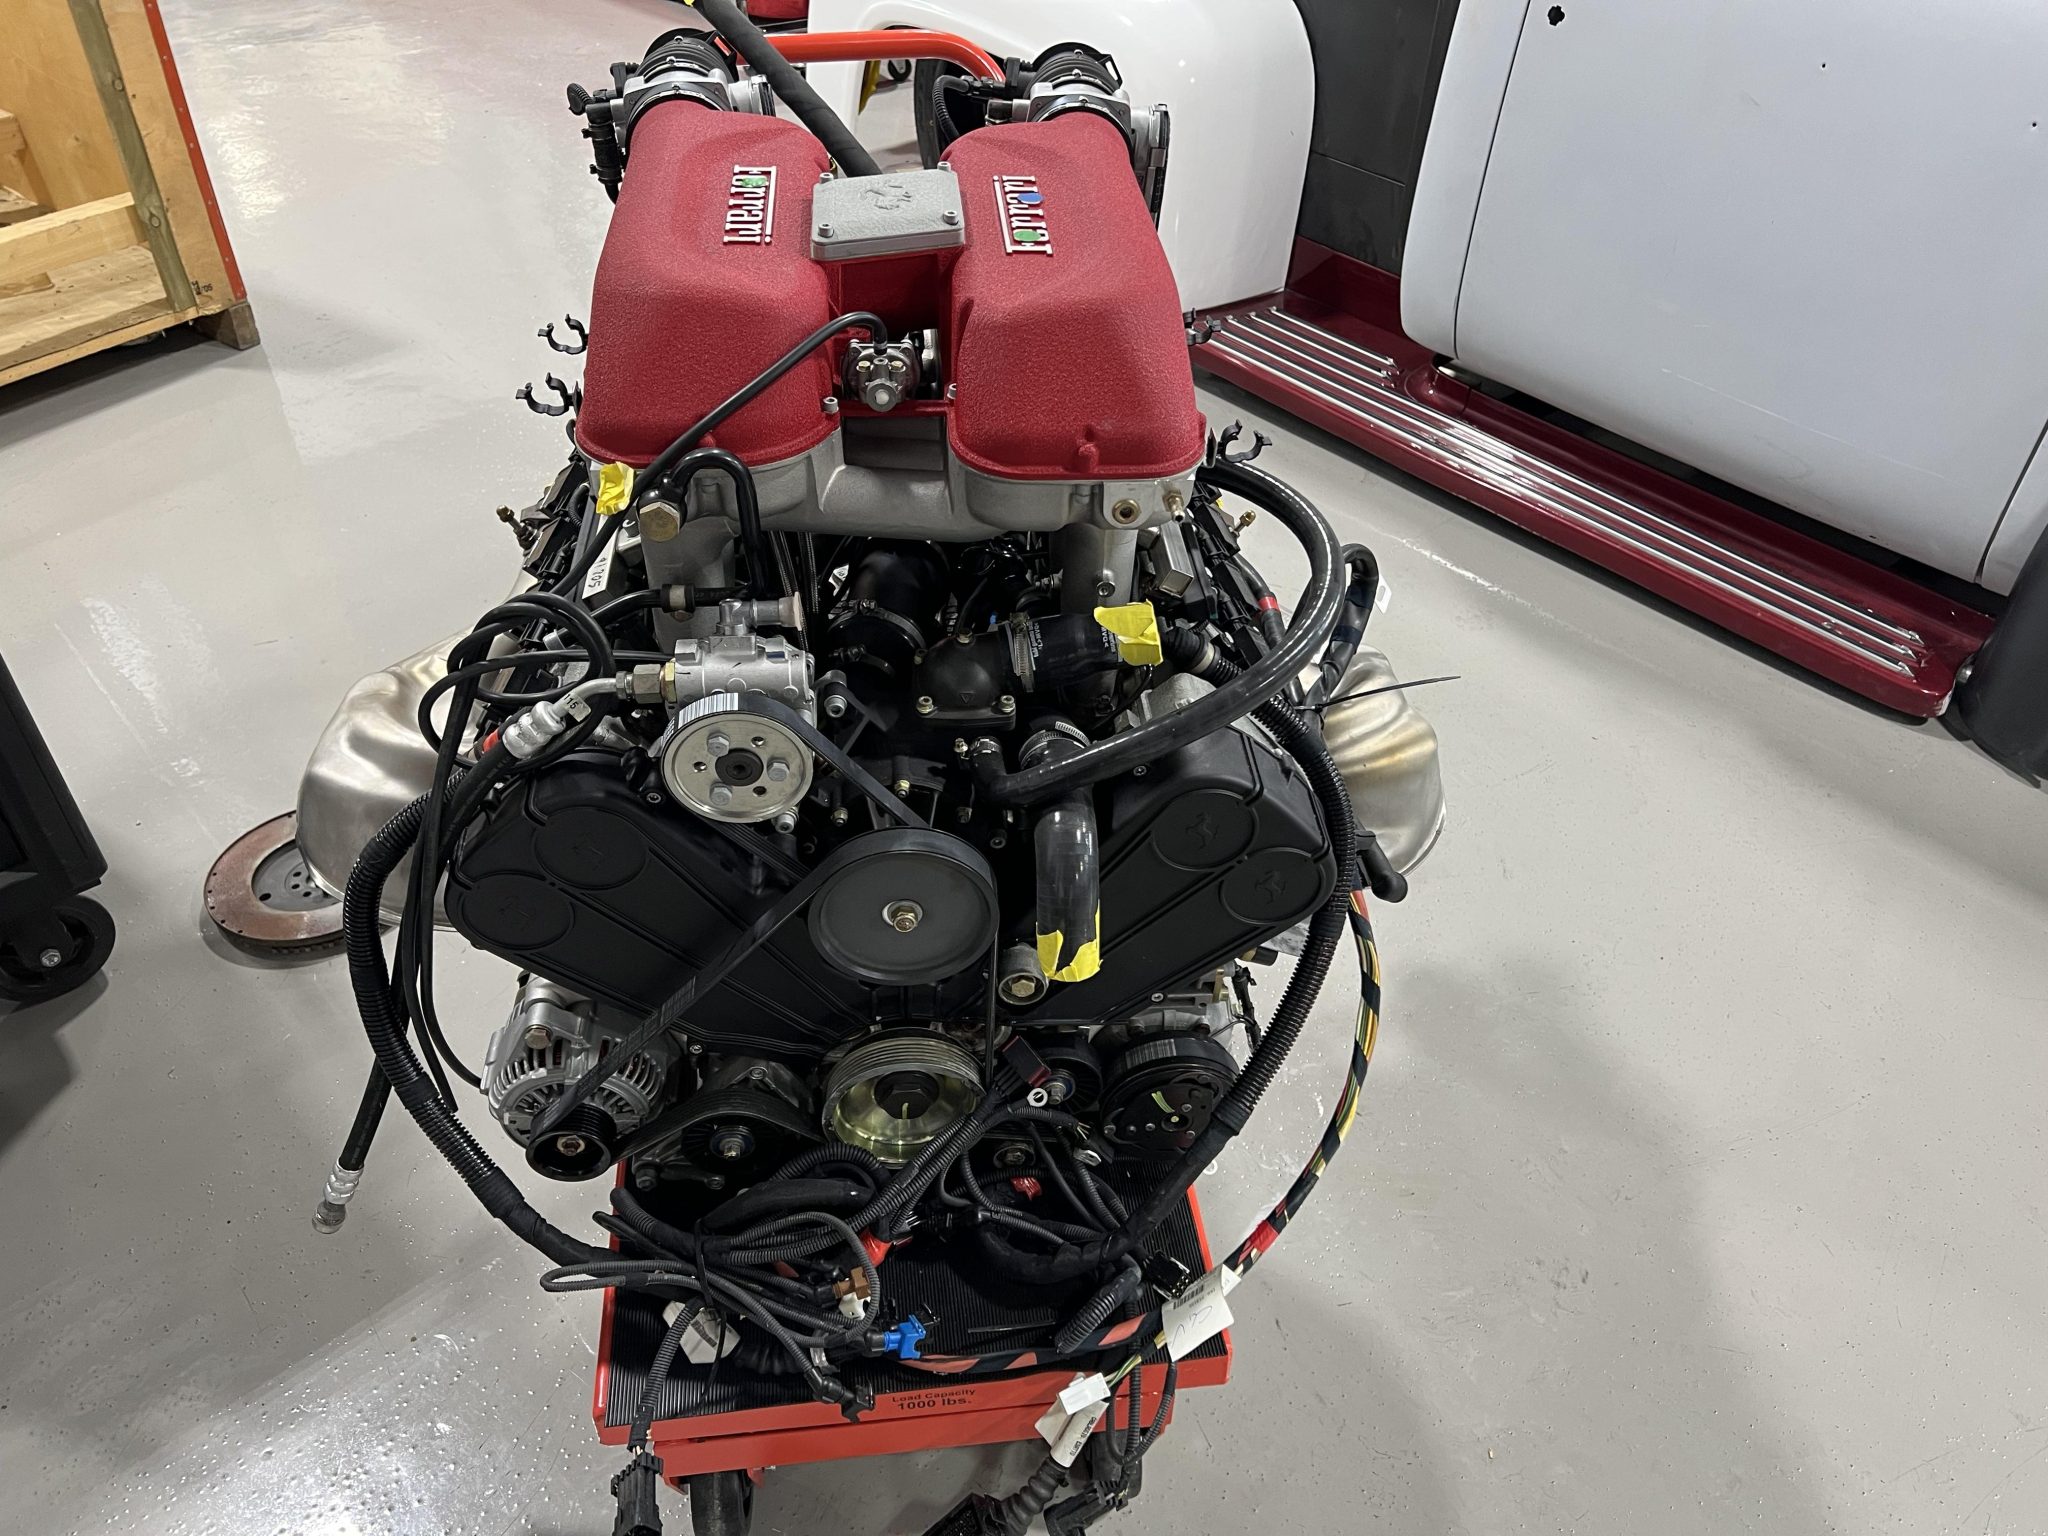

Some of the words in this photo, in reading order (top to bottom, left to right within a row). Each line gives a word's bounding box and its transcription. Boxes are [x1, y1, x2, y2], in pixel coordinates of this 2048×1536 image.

[724, 165, 777, 243] Ferrari
[892, 1393, 921, 1402] Load
[925, 1389, 976, 1399] Capacity
[898, 1400, 936, 1410] 1000
[942, 1398, 972, 1406] lbs.
